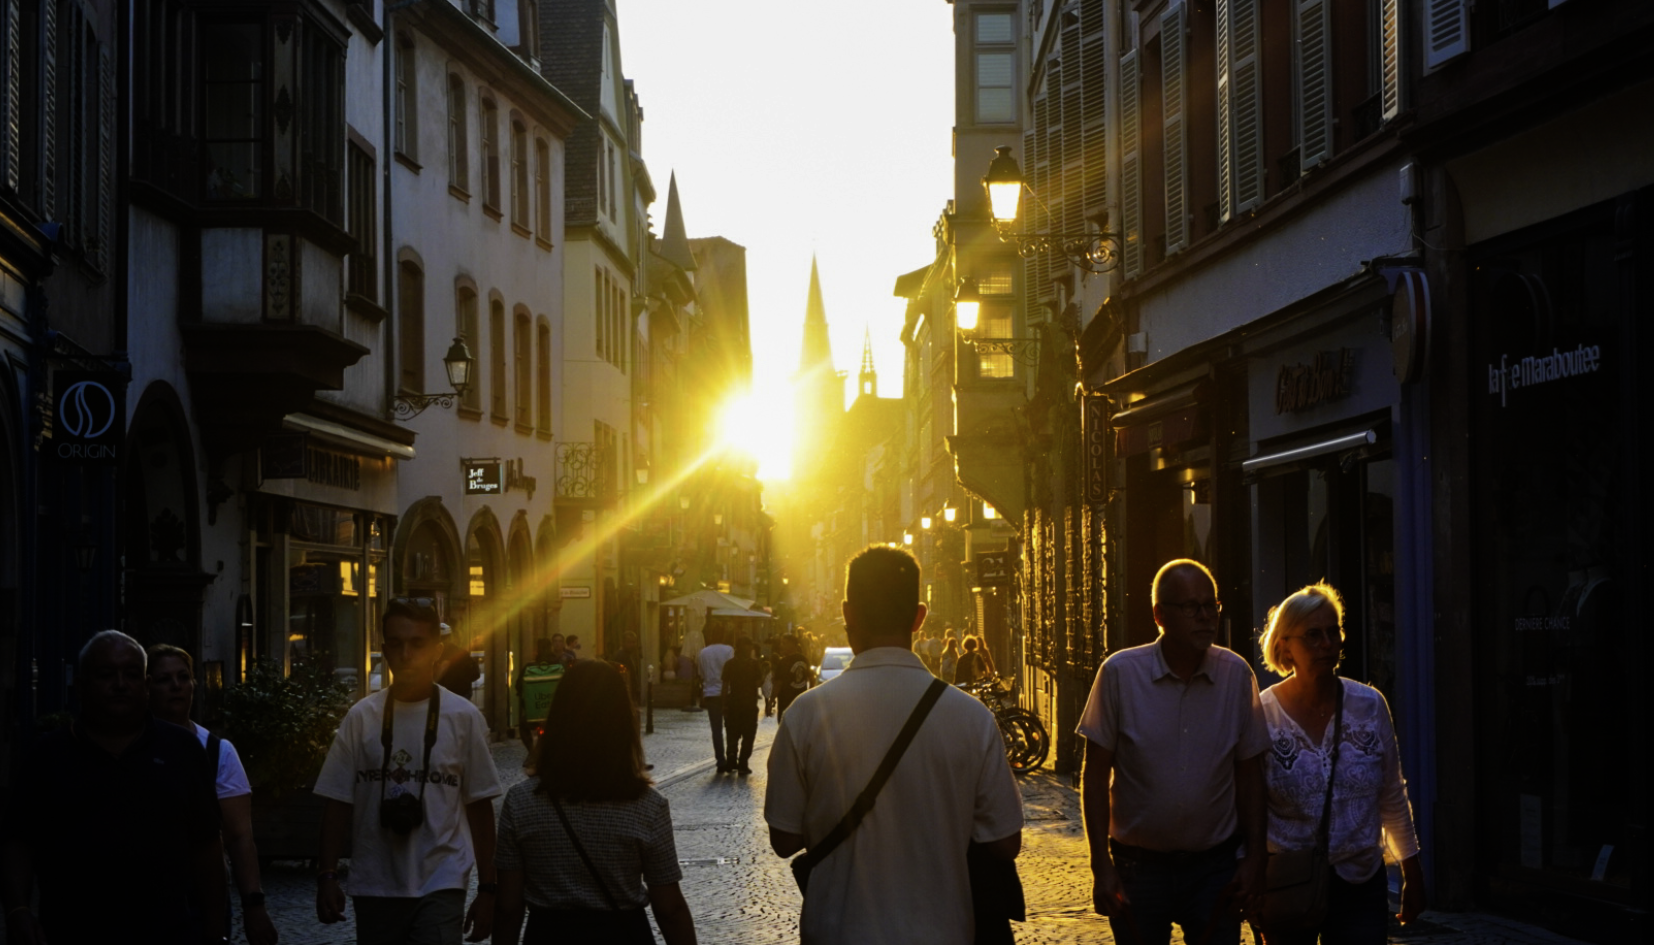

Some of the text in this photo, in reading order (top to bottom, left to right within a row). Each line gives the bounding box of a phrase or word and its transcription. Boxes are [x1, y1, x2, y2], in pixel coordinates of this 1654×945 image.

[57, 442, 116, 459] ORIGIN
[1090, 404, 1103, 496] NICOLAS
[307, 447, 361, 492] LIBRAIRIE
[468, 467, 485, 479] Jeff
[468, 480, 499, 492] Bruges
[981, 556, 1007, 578] 21
[1544, 615, 1571, 631] CHANCE
